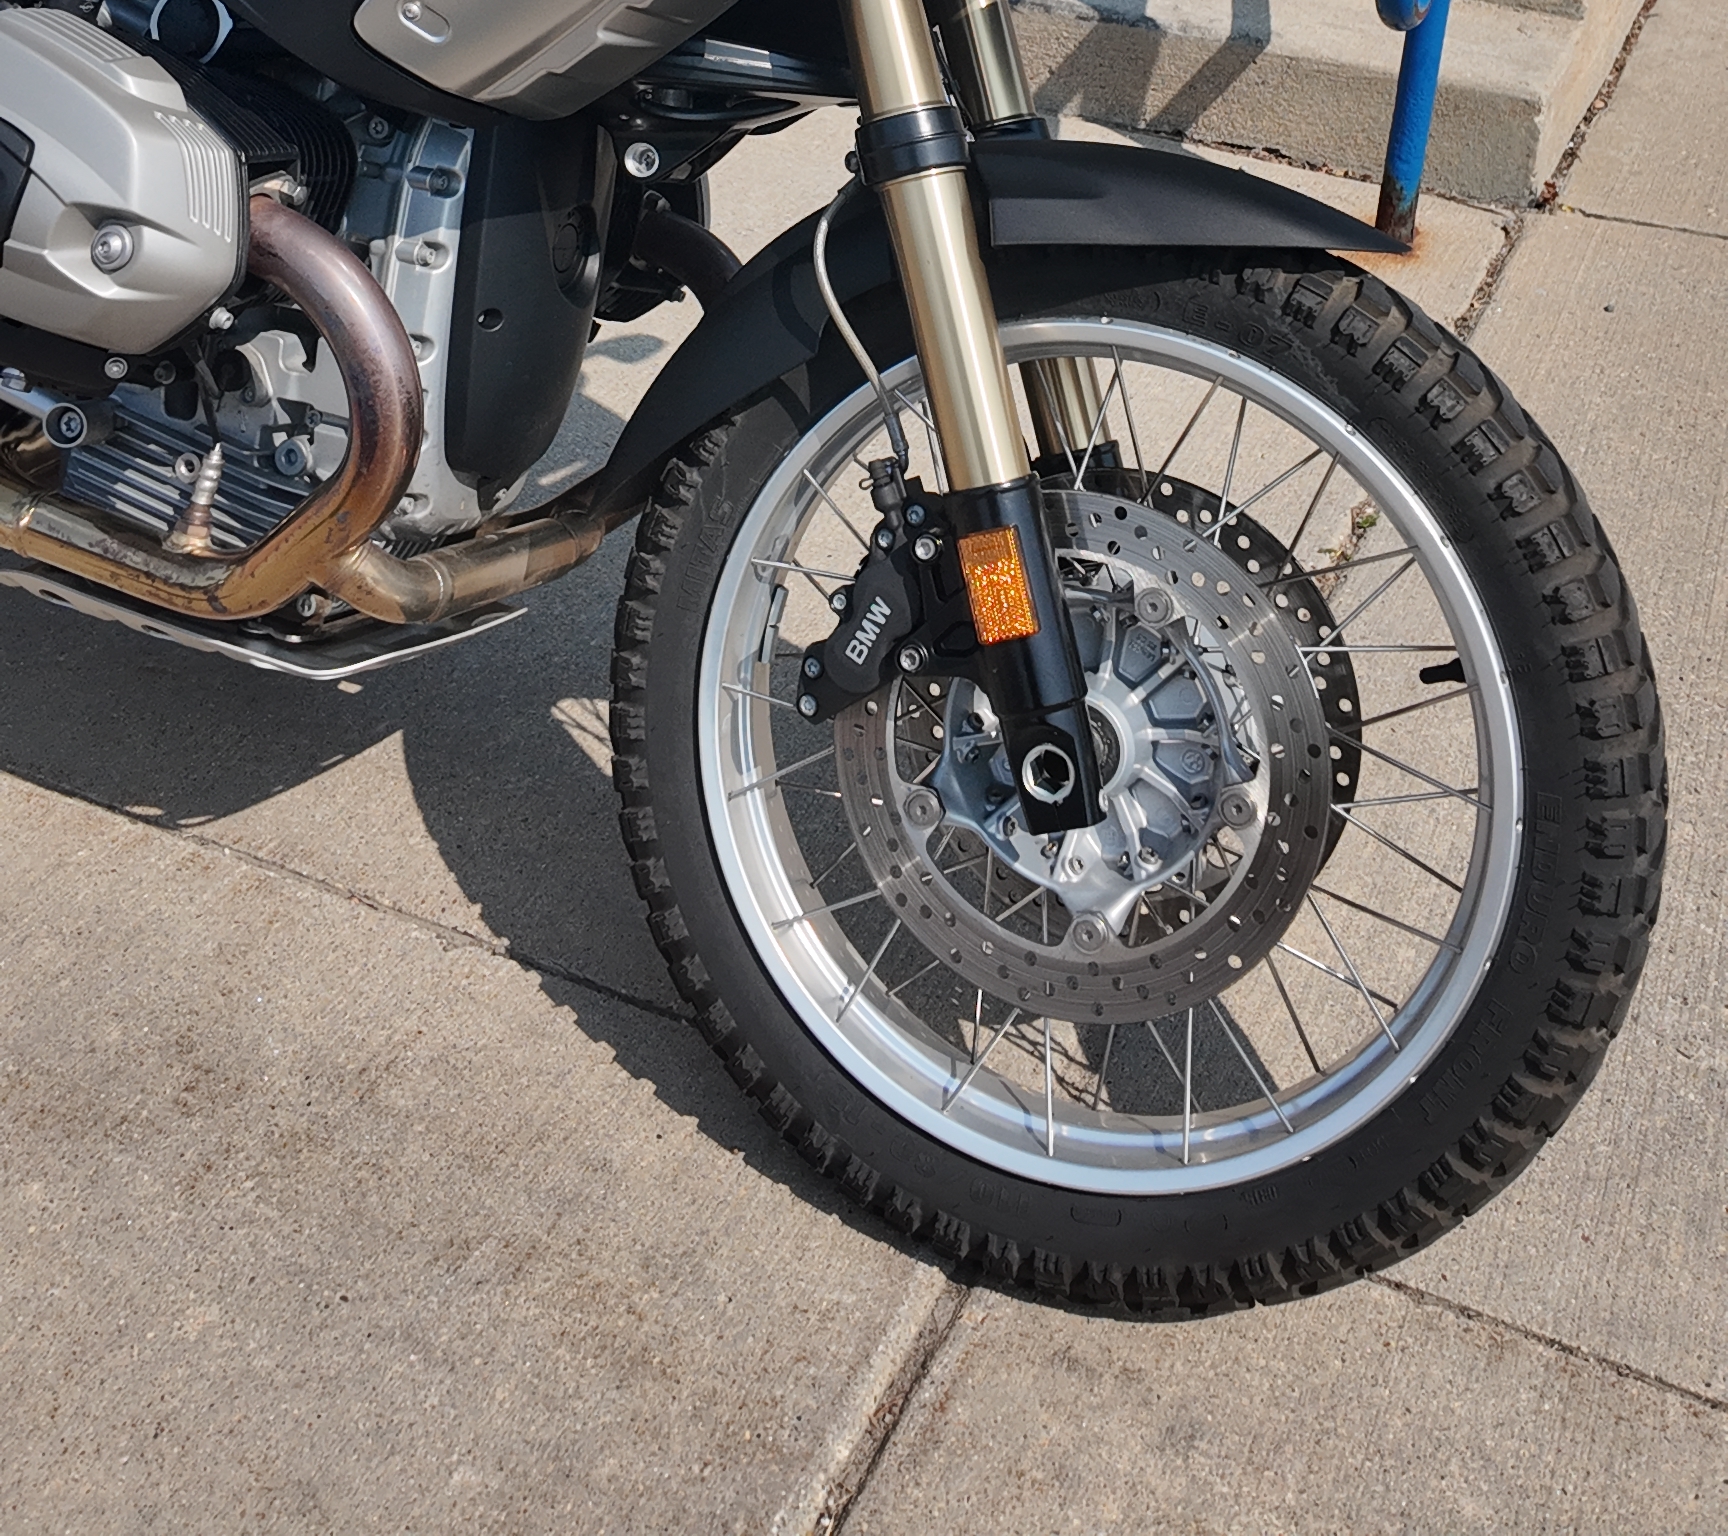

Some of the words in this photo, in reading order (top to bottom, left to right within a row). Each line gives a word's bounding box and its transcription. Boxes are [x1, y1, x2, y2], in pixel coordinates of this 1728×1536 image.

[676, 495, 735, 614] MITAS
[845, 596, 892, 666] BMW
[1509, 791, 1564, 976] ENDURO
[1418, 997, 1514, 1126] FRONT
